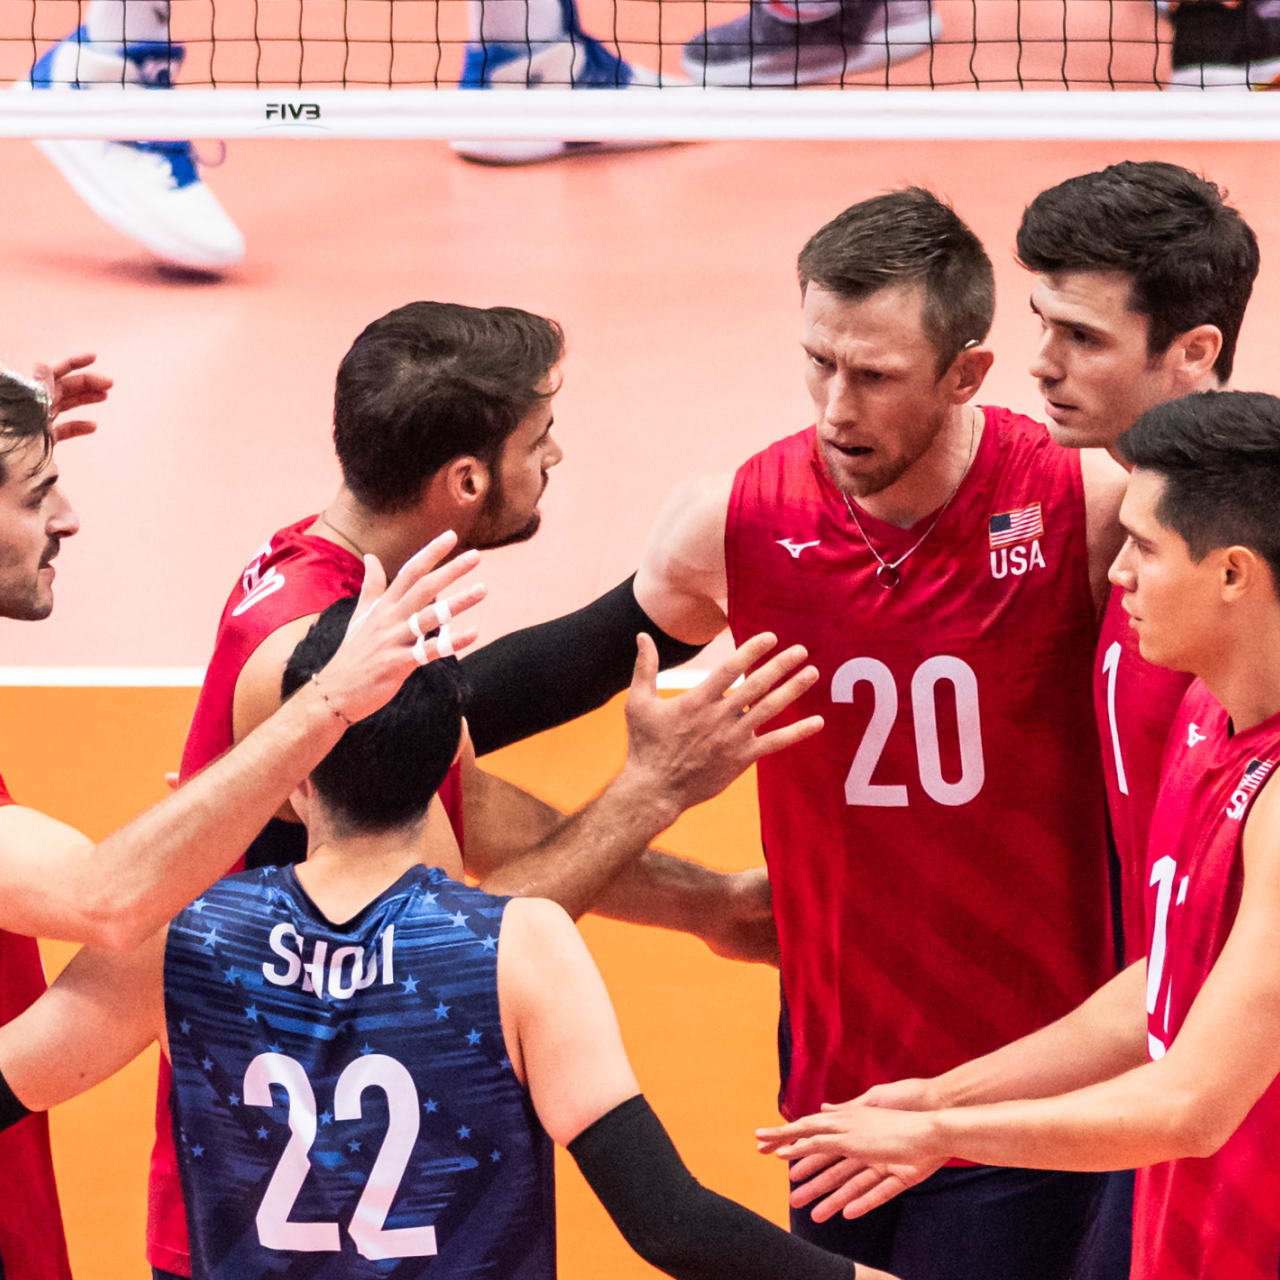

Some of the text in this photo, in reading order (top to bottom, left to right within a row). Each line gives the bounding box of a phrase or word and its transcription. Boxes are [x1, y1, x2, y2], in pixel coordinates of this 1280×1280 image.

[266, 103, 321, 120] FIVB
[990, 540, 1046, 579] USA
[830, 655, 986, 807] 20
[1102, 641, 1129, 796] 1
[243, 1052, 438, 1261] 22
